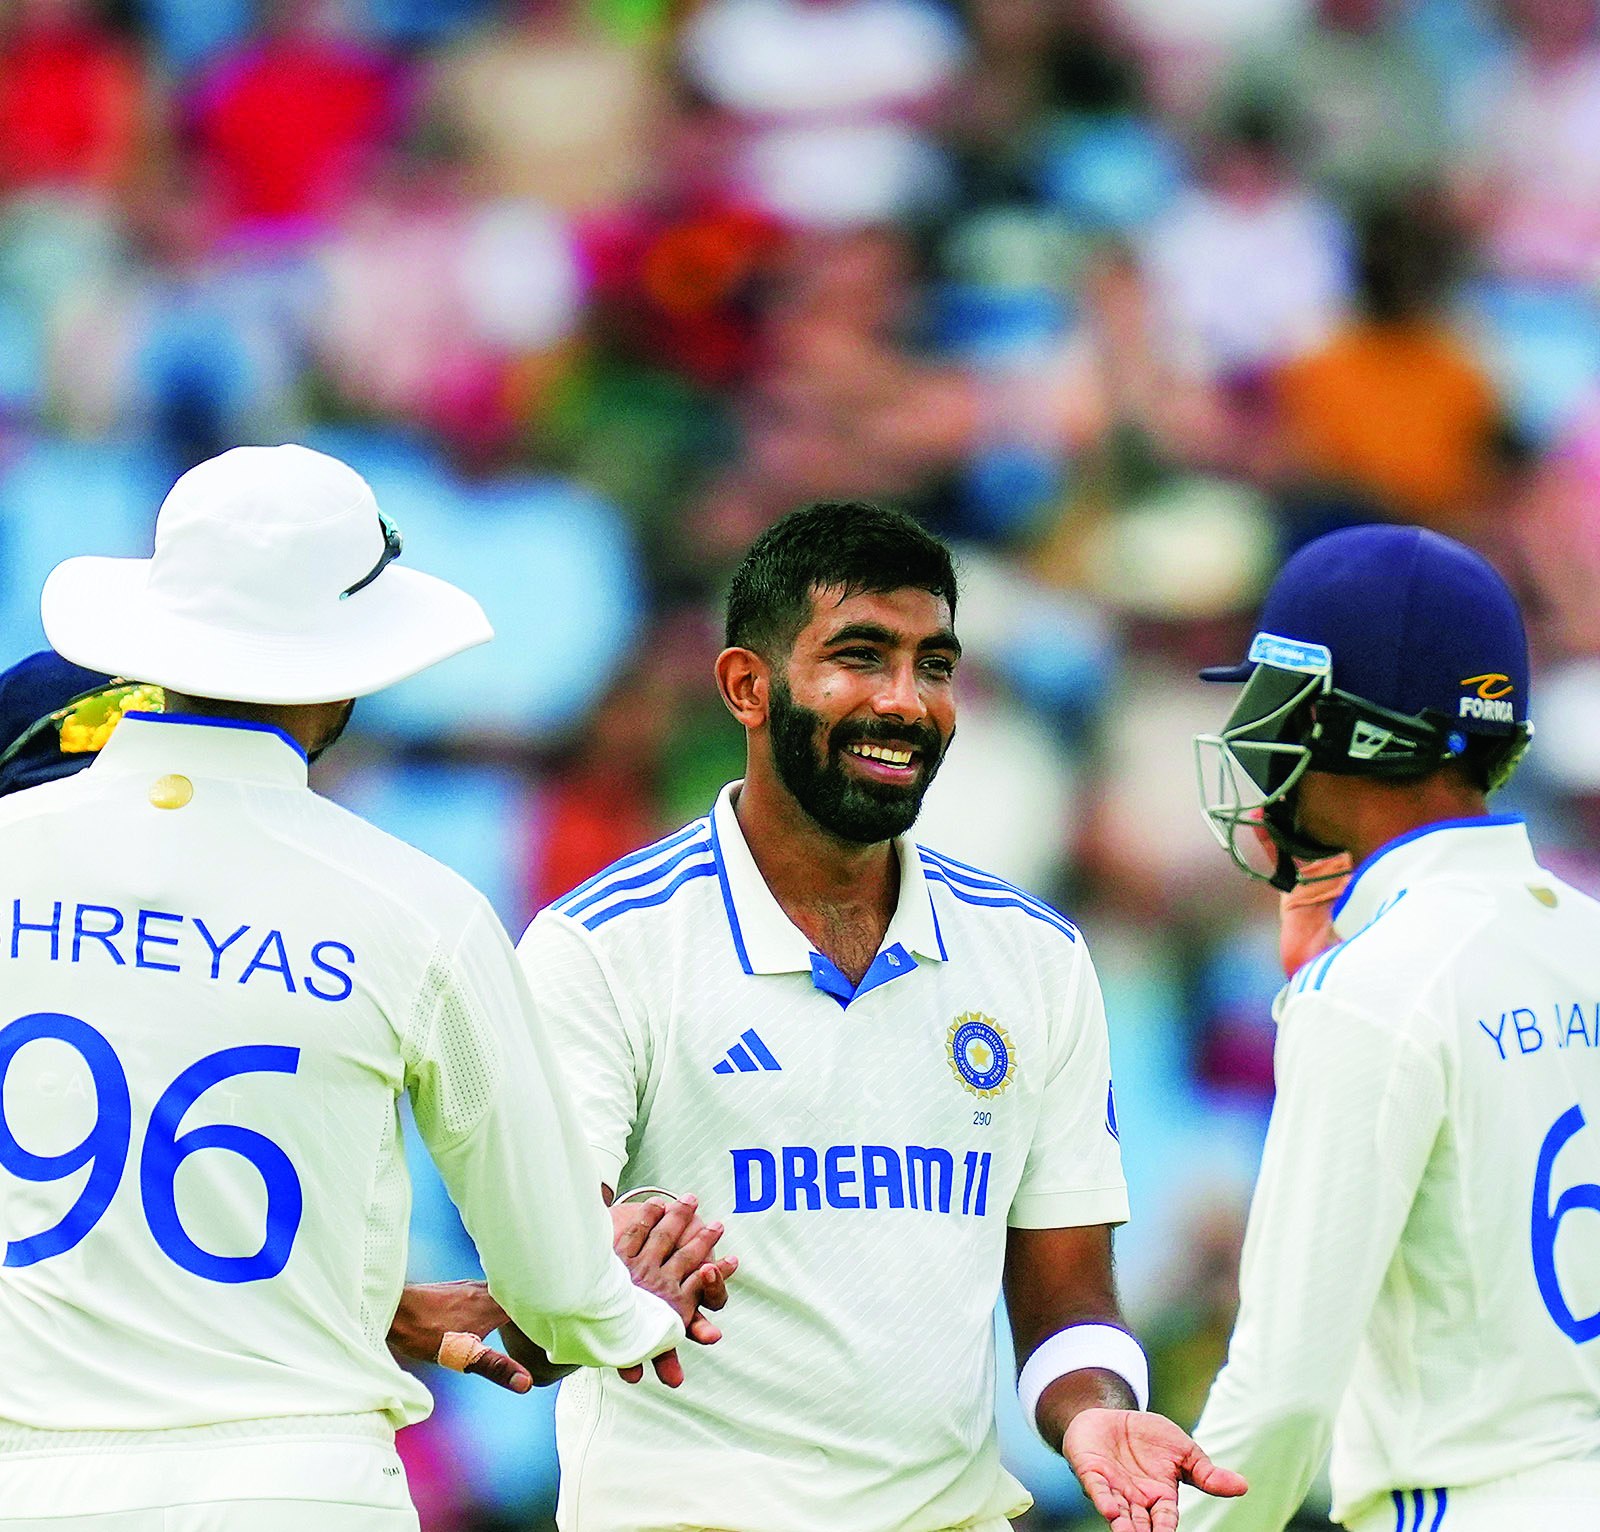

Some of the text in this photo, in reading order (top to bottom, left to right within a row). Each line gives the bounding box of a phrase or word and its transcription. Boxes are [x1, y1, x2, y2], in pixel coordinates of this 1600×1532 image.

[986, 1032, 1002, 1056] CRICKET
[1478, 1007, 1545, 1061] YB
[973, 1111, 992, 1126] 290
[730, 1145, 992, 1217] DREAM11
